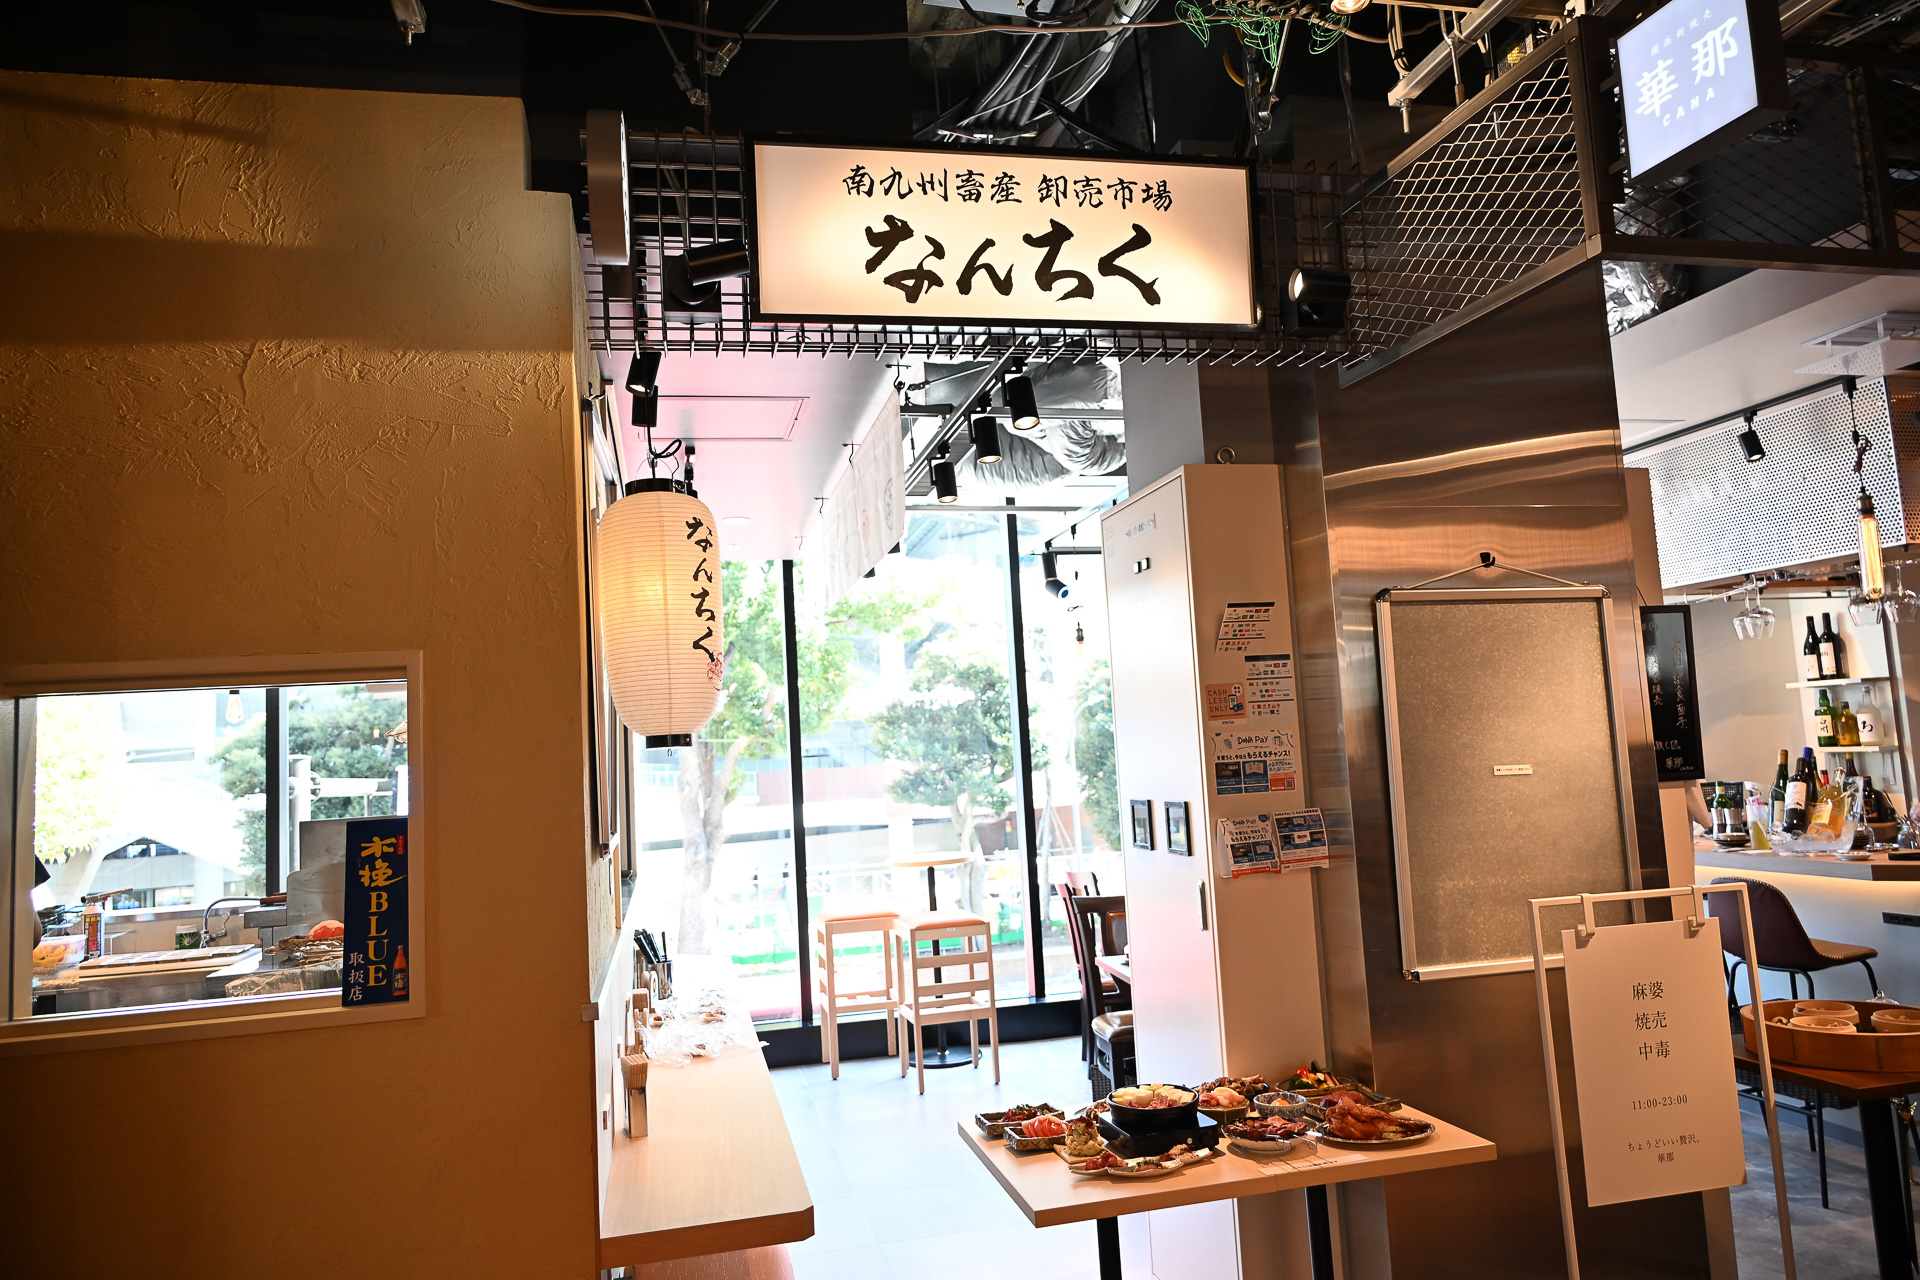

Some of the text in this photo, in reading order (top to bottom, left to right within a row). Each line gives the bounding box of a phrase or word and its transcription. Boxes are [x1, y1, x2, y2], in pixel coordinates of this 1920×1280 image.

[1634, 16, 1739, 119] 華那
[1662, 87, 1716, 127] CANA
[841, 164, 1174, 212] 南九州畜産 卸売市場
[864, 214, 1161, 306] なんちく
[685, 516, 716, 662] なんちく
[1207, 689, 1228, 697] CASH
[1208, 697, 1228, 705] LESS
[1209, 705, 1228, 713] ONLY
[348, 951, 366, 1001] 取扱店
[1631, 980, 1664, 1001] 麻婆
[1634, 1010, 1667, 1031] 焼売
[1638, 1039, 1671, 1061] 中毒
[1631, 1094, 1688, 1110] 11:00-23:00
[1627, 1133, 1700, 1152] ちょうどいい贅沢。
[1657, 1151, 1675, 1163] 華那
